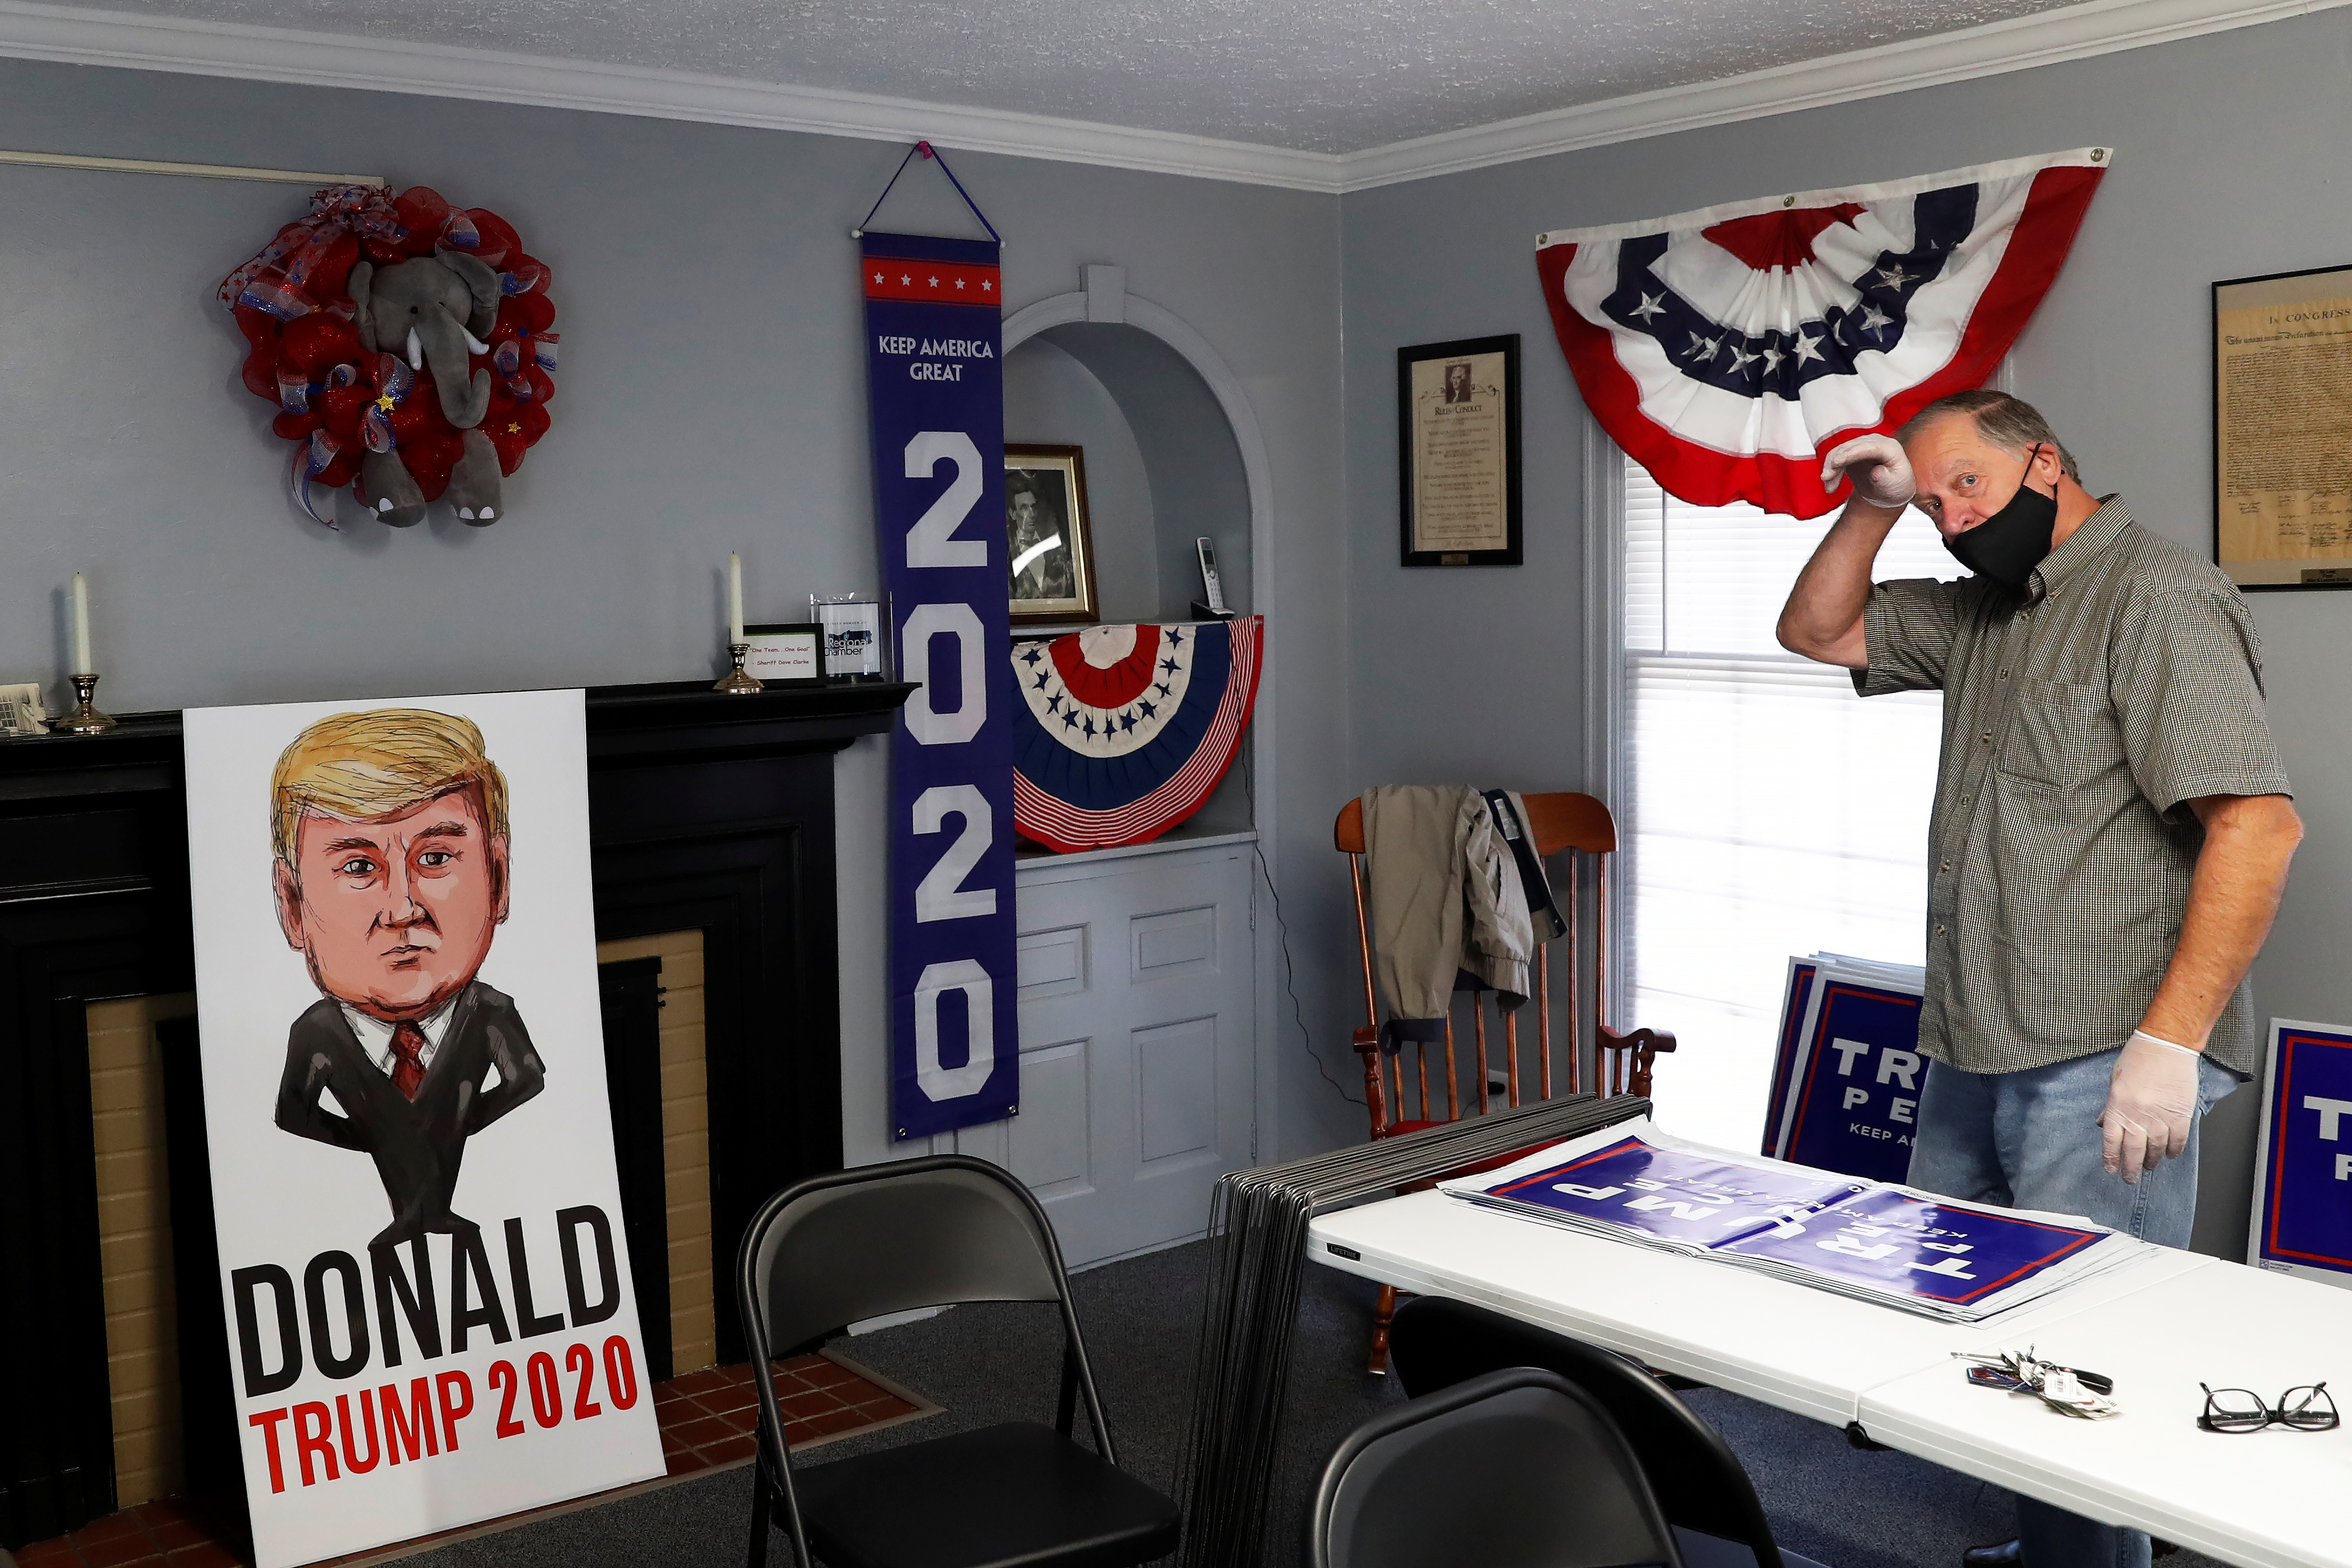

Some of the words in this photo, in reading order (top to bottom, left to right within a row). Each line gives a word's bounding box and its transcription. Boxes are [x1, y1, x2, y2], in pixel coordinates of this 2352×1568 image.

[879, 336, 916, 354] KEEP
[920, 338, 994, 358] AMERICA
[910, 363, 962, 381] GREAT
[1849, 1123, 1892, 1140] KEEP
[1623, 1177, 1975, 1254] PENCE
[1552, 1183, 1977, 1280] TRUMP
[1893, 1222, 1968, 1238] KEEP
[1330, 1246, 1357, 1258] LIFETIME
[231, 1205, 621, 1398] DONALD
[248, 1370, 475, 1494] TRUMP
[488, 1335, 639, 1439] 2020
